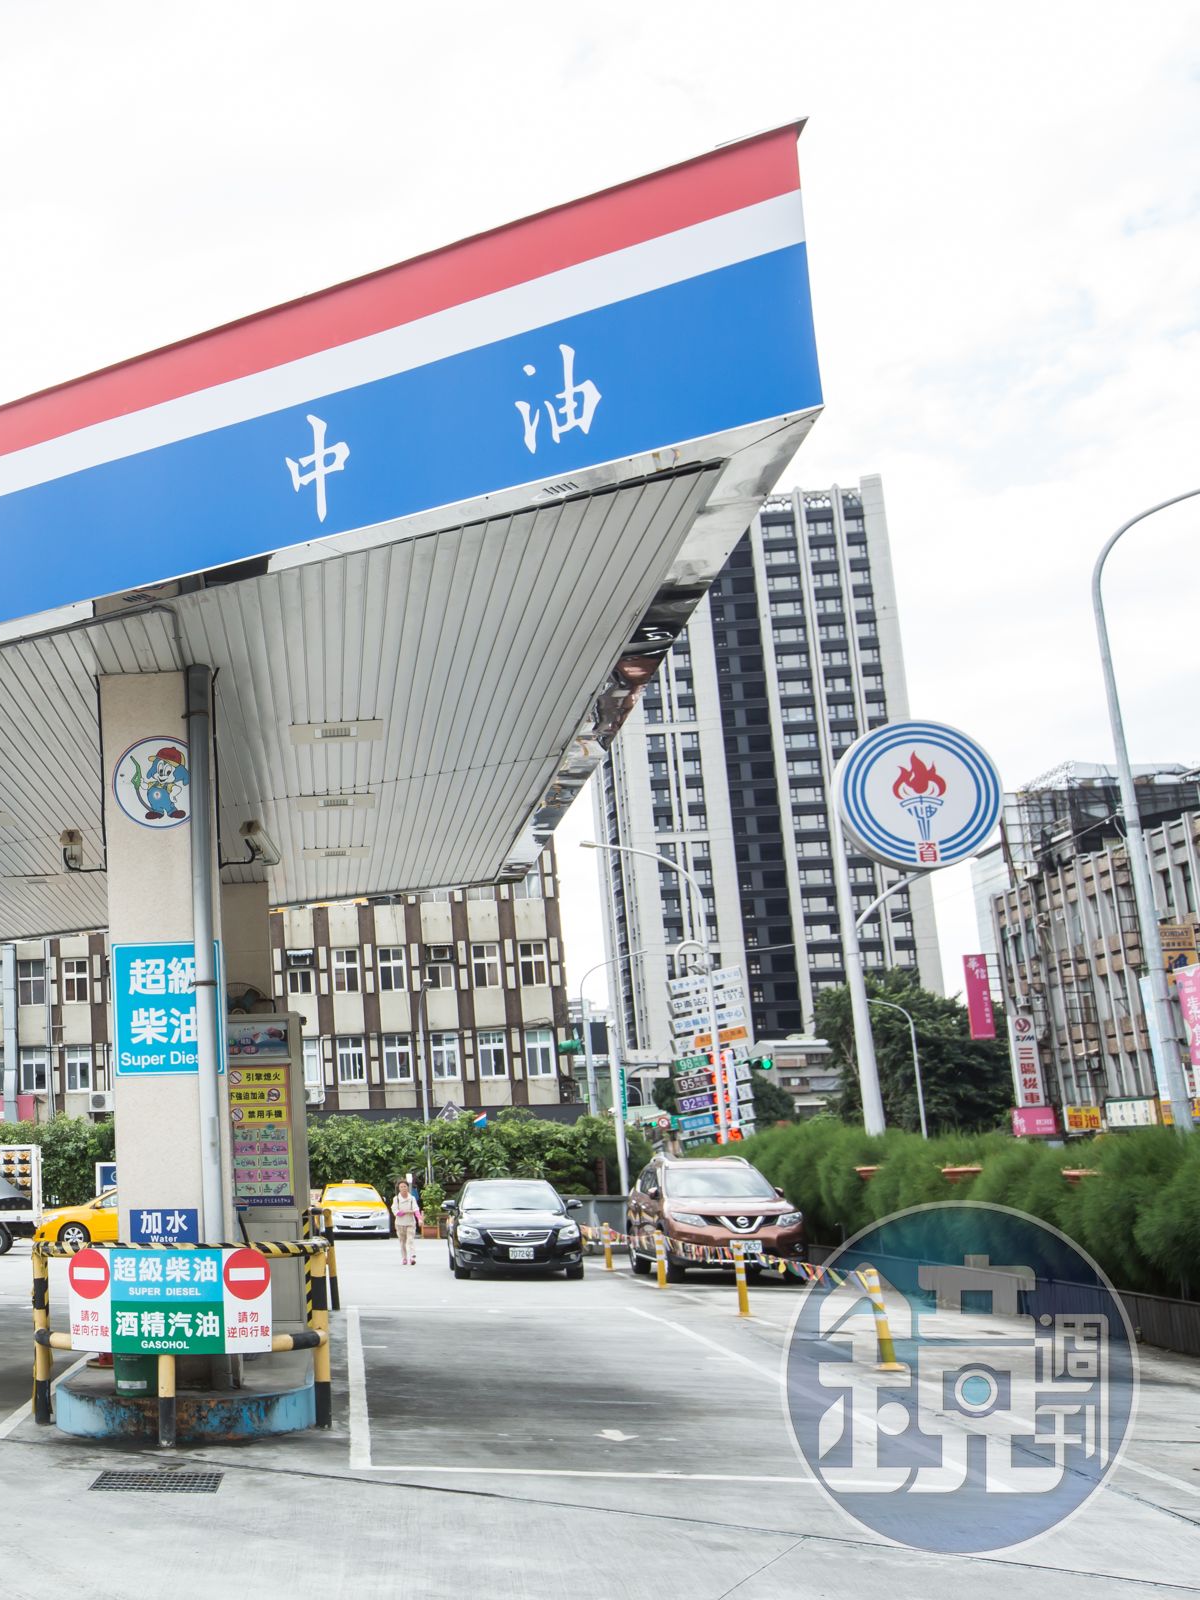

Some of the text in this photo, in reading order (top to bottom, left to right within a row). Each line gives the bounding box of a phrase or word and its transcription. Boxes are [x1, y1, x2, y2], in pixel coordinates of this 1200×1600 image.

[285, 344, 602, 523] 中油
[129, 957, 197, 996] 超級
[130, 1007, 199, 1045] 柴油
[1015, 1034, 1035, 1042] SYM
[120, 1051, 200, 1068] Super Die
[680, 1058, 693, 1070] 98
[245, 1072, 281, 1082] 引擎熄火
[681, 1078, 695, 1090] 95
[682, 1098, 696, 1110] 92
[247, 1109, 282, 1119] 禁用手機
[1068, 1113, 1101, 1130] 電池
[140, 1210, 188, 1235] 加水
[150, 1234, 177, 1243] Water
[114, 1257, 218, 1283] 超級柴油
[129, 1286, 202, 1297] SUPER DIESEL
[80, 1310, 99, 1322] 請勿
[238, 1311, 259, 1324] 請勿
[72, 1324, 110, 1338] 逆向行駛
[115, 1310, 220, 1339] 酒精汽油
[227, 1325, 270, 1339] 逆向行駛
[141, 1340, 190, 1350] GASOHOL
